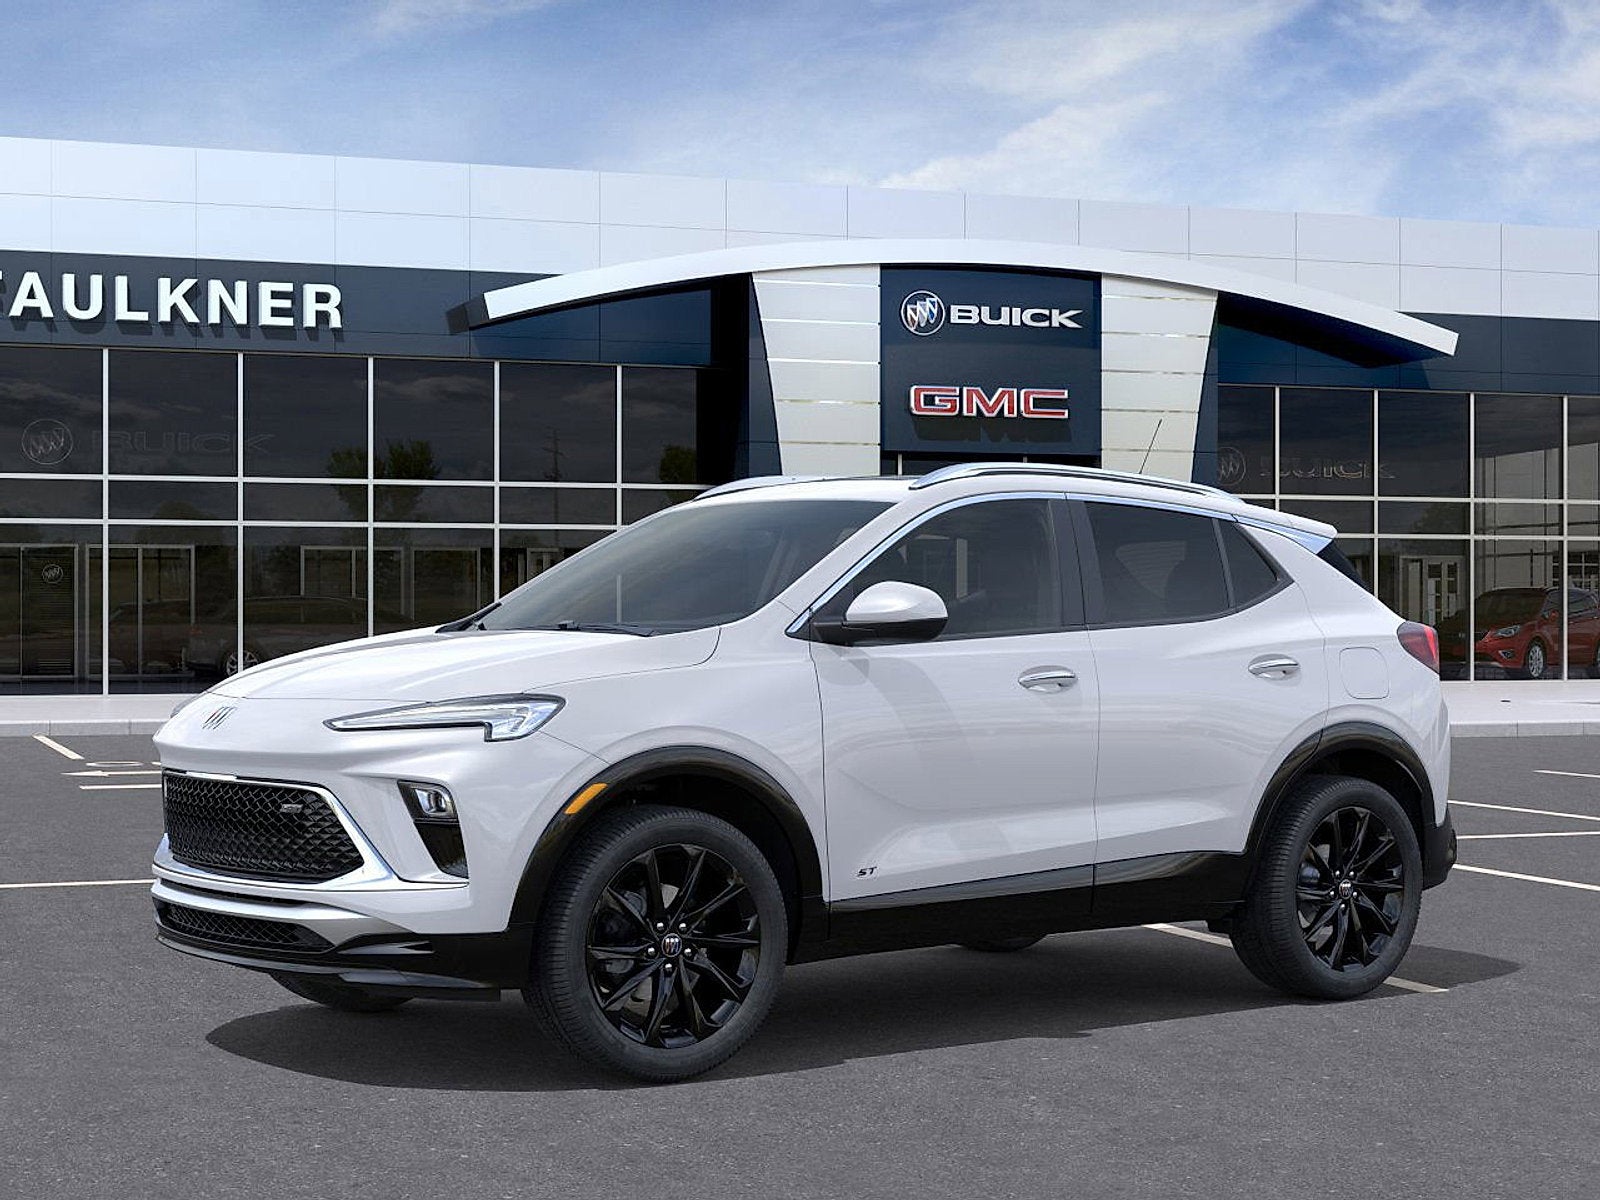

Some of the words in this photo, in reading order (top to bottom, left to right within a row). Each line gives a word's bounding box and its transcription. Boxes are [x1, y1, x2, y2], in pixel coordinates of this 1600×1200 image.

[0, 270, 343, 329] AULKNER
[950, 304, 1083, 329] BUICK
[910, 385, 1069, 419] GMC
[857, 866, 878, 877] ST
